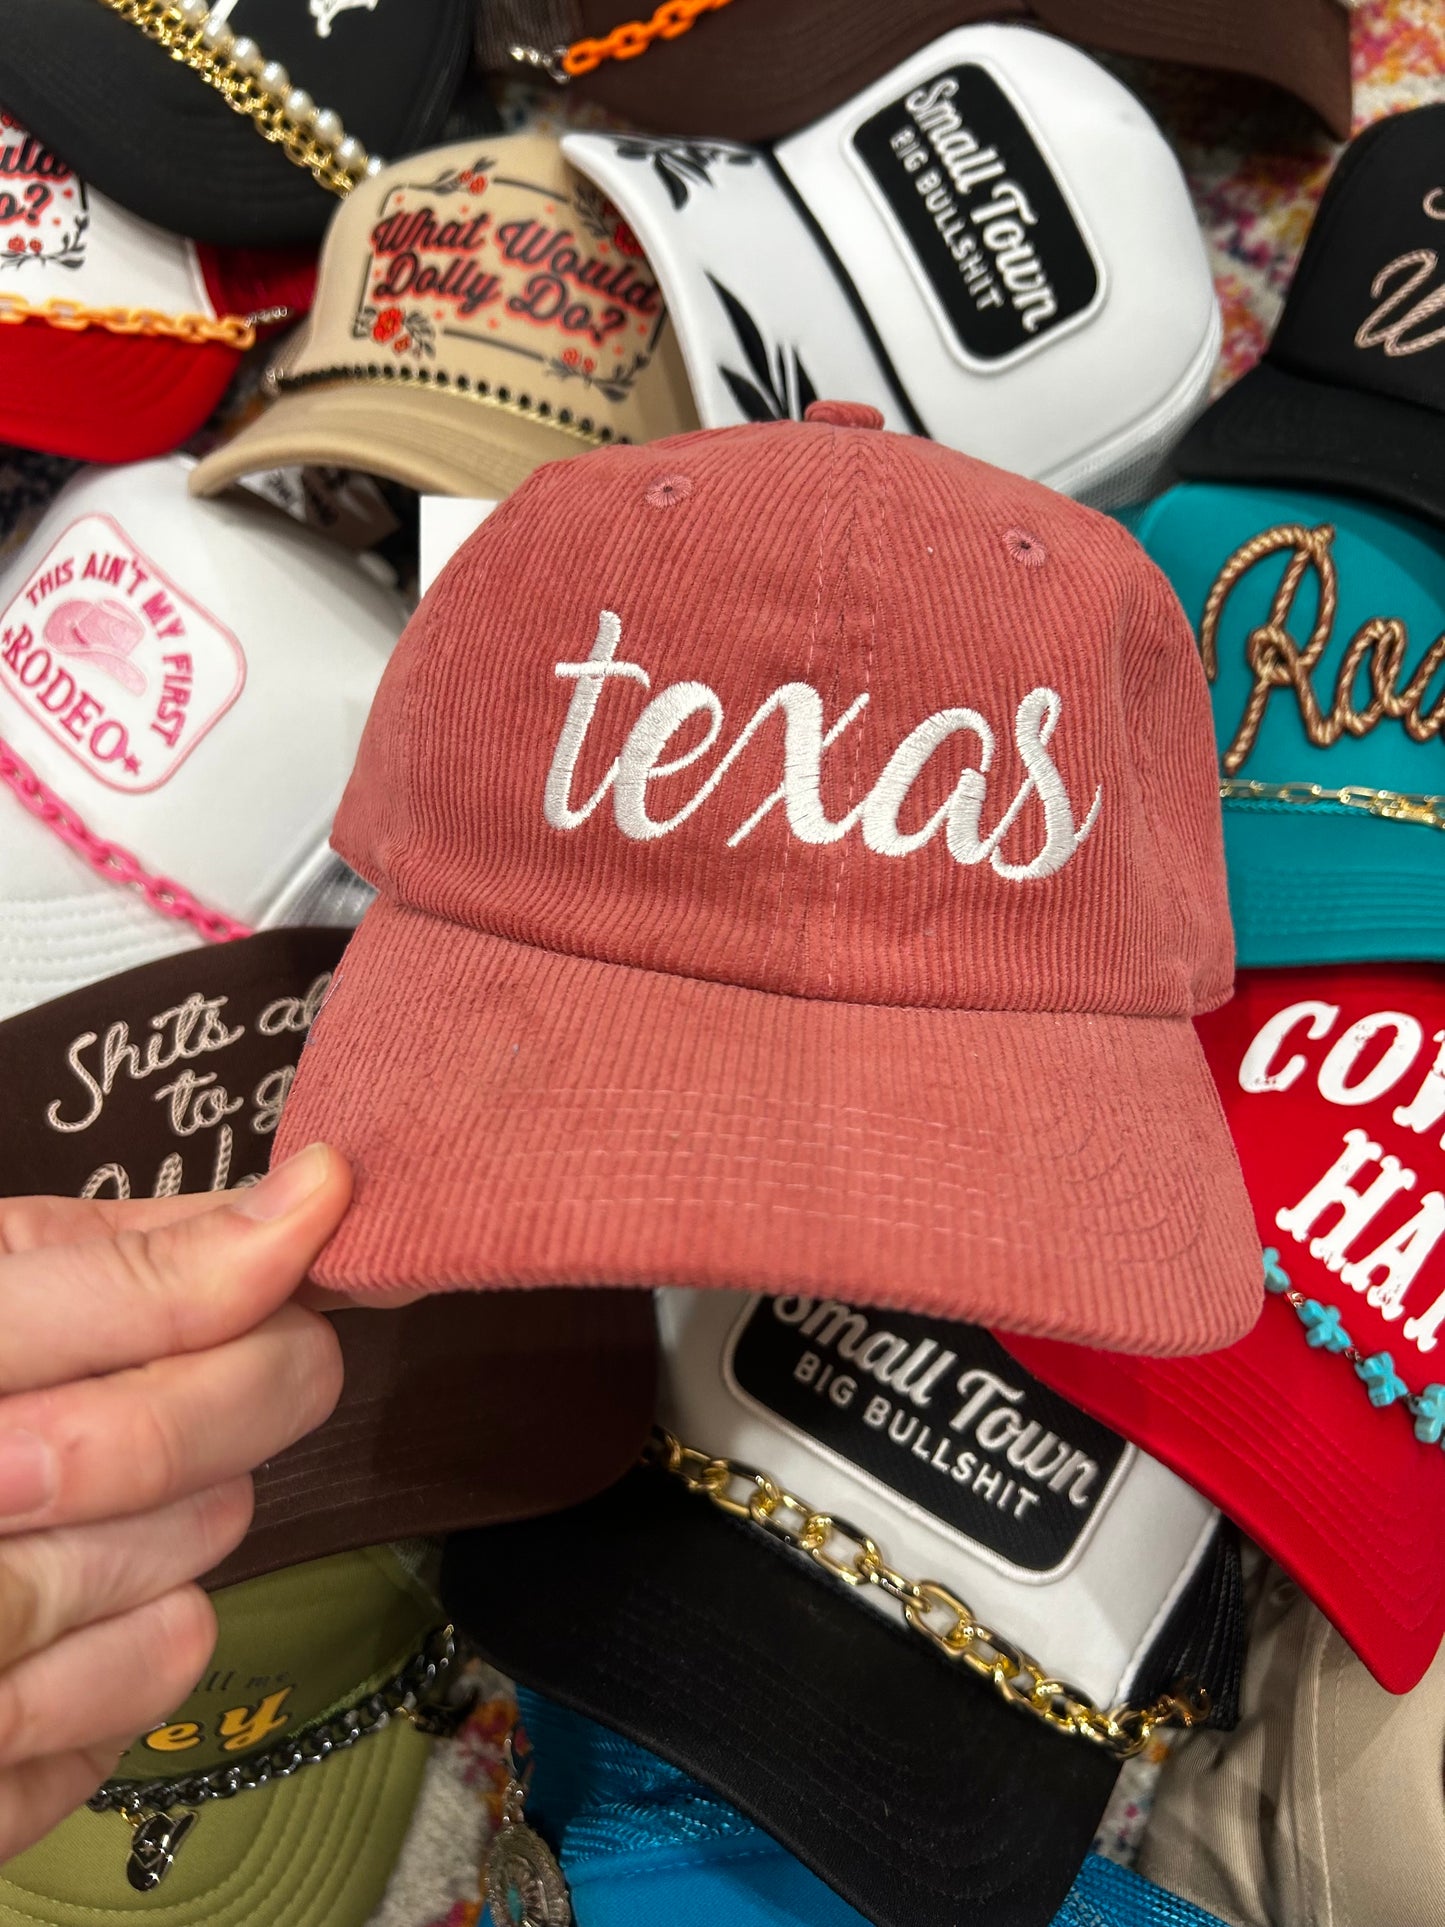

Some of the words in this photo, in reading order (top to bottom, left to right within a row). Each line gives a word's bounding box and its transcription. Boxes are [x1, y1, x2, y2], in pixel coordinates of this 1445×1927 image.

[371, 206, 490, 256] What
[496, 219, 659, 314] Would
[889, 124, 929, 174] BIG
[915, 166, 1004, 312] BULLSHIT
[905, 76, 1006, 194] Small
[970, 180, 1058, 333] Town
[373, 252, 501, 318] Dolly
[507, 272, 627, 345] Do?
[26, 557, 75, 608] THIS
[81, 552, 149, 597] AIN'T
[142, 590, 186, 640] MY
[2, 624, 129, 763] RODEO
[150, 652, 194, 749] FIRST
[543, 610, 1101, 882] texas
[155, 1068, 244, 1136] to
[1275, 1128, 1445, 1352] HA
[793, 1349, 858, 1408] BIG
[862, 1396, 1040, 1520] BULLSHIT
[949, 1367, 1100, 1510] Town
